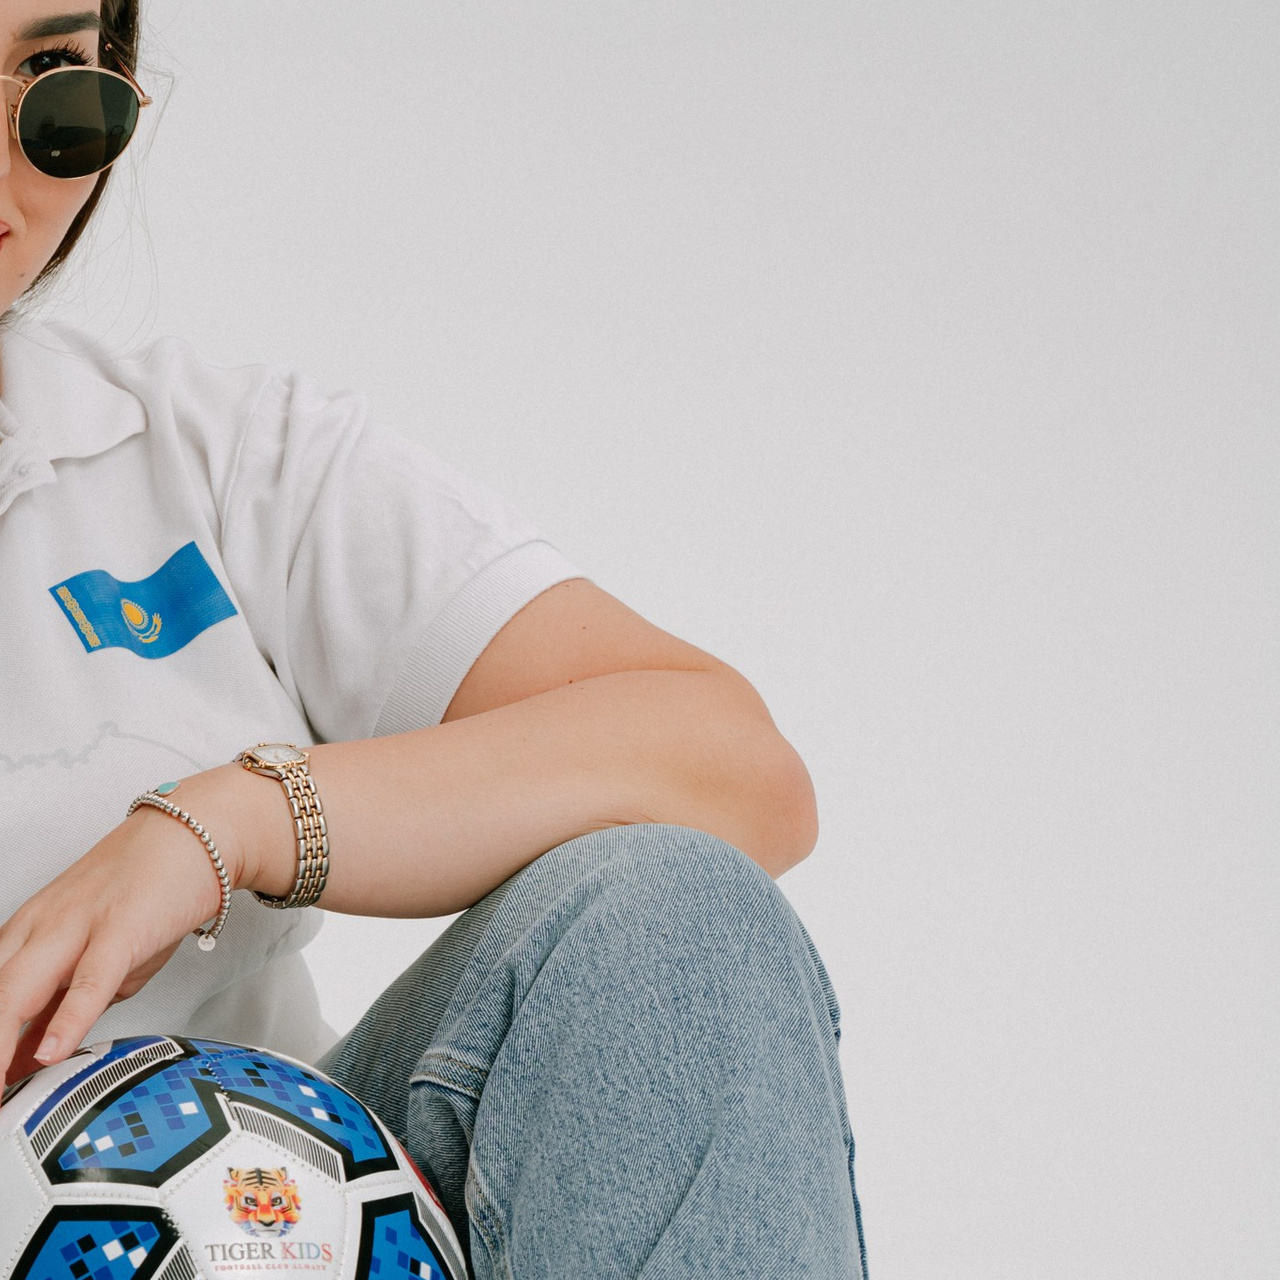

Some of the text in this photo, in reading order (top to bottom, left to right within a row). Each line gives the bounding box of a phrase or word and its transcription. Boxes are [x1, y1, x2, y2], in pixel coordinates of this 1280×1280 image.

[204, 1241, 333, 1263] TIGER KIDS
[214, 1263, 263, 1272] FOOTBALL
